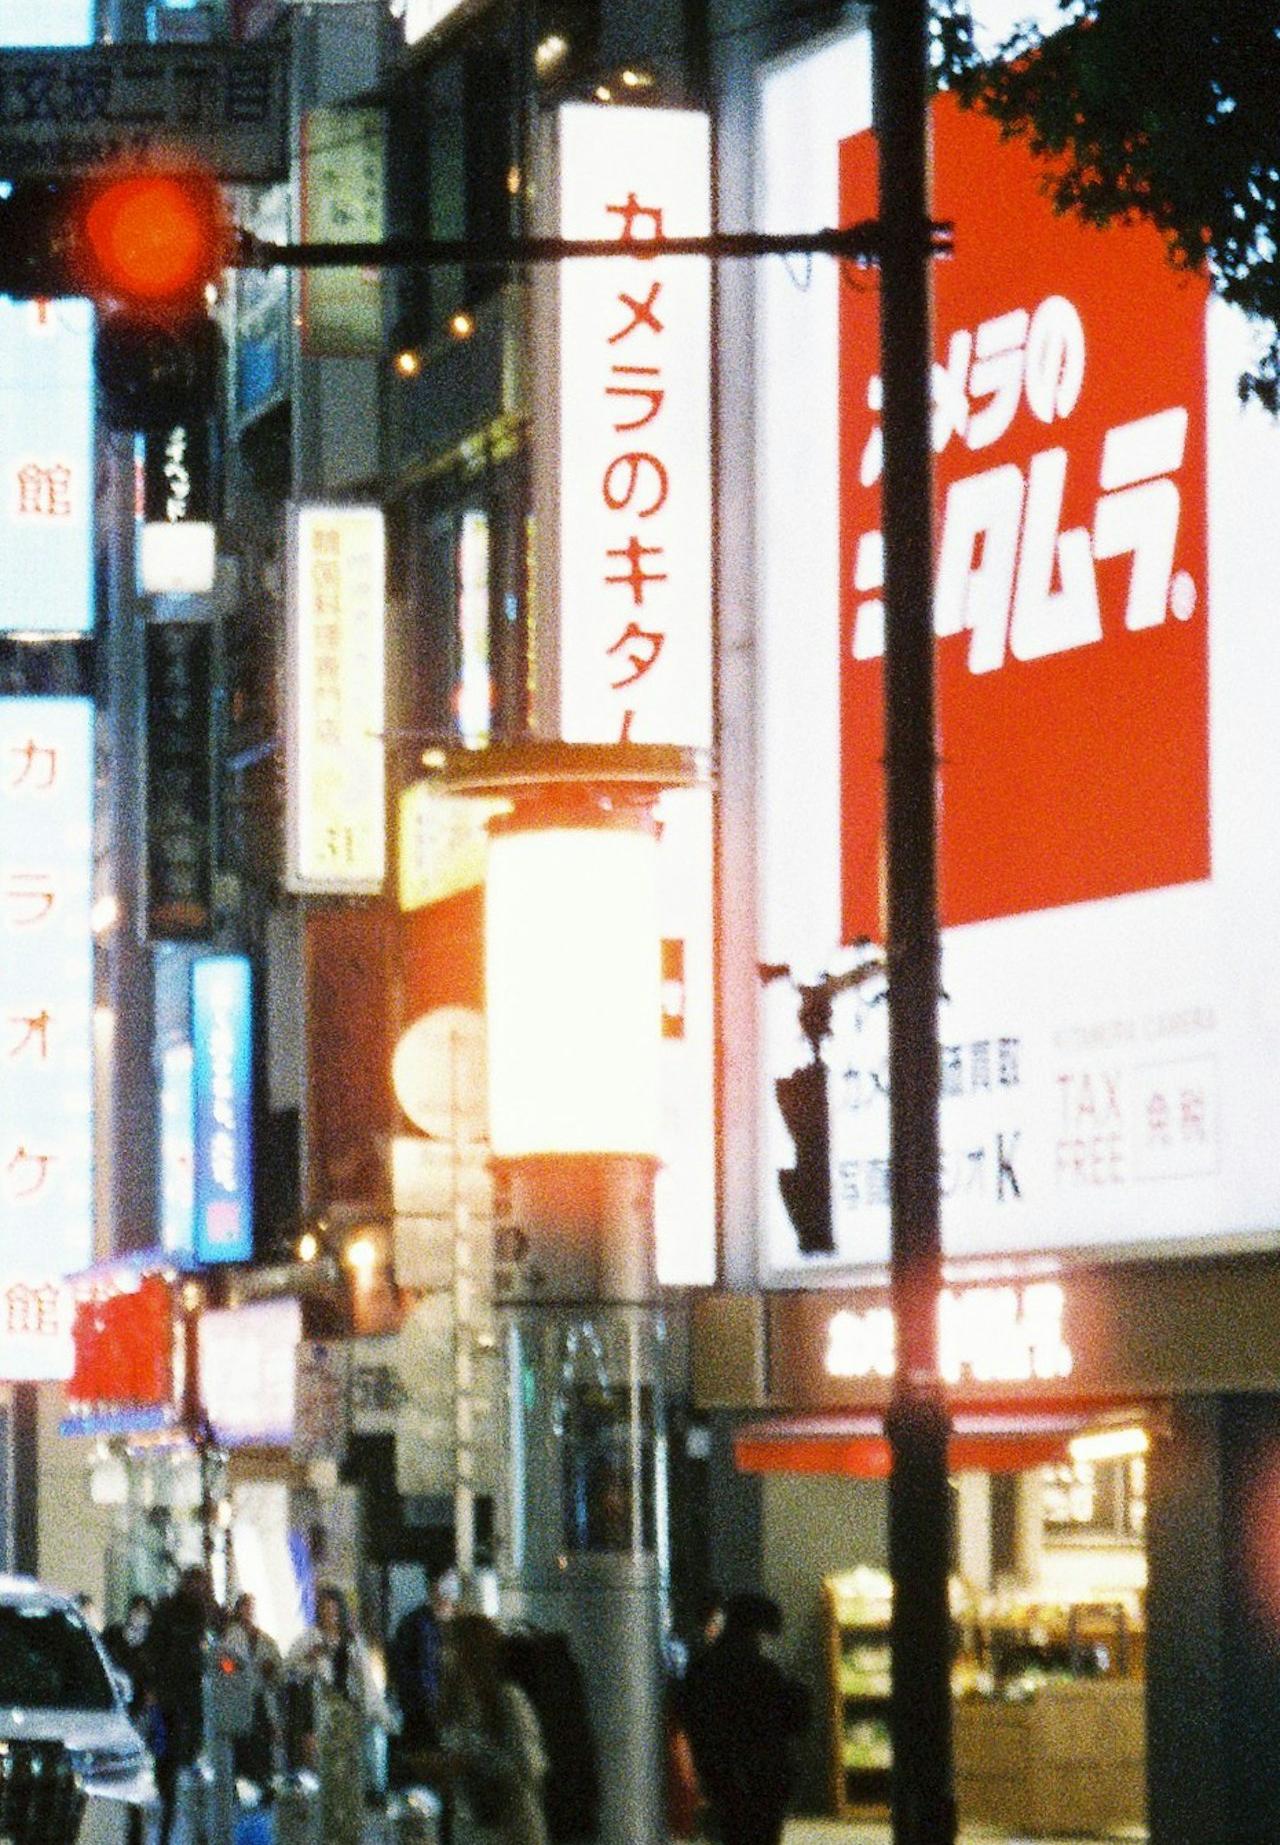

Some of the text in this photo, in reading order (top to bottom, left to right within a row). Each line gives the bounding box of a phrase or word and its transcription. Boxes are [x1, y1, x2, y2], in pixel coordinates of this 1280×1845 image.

[3, 737, 60, 1335] カラオケ館
[1054, 1068, 1122, 1128] TAX
[1055, 1131, 1123, 1186] FREE
